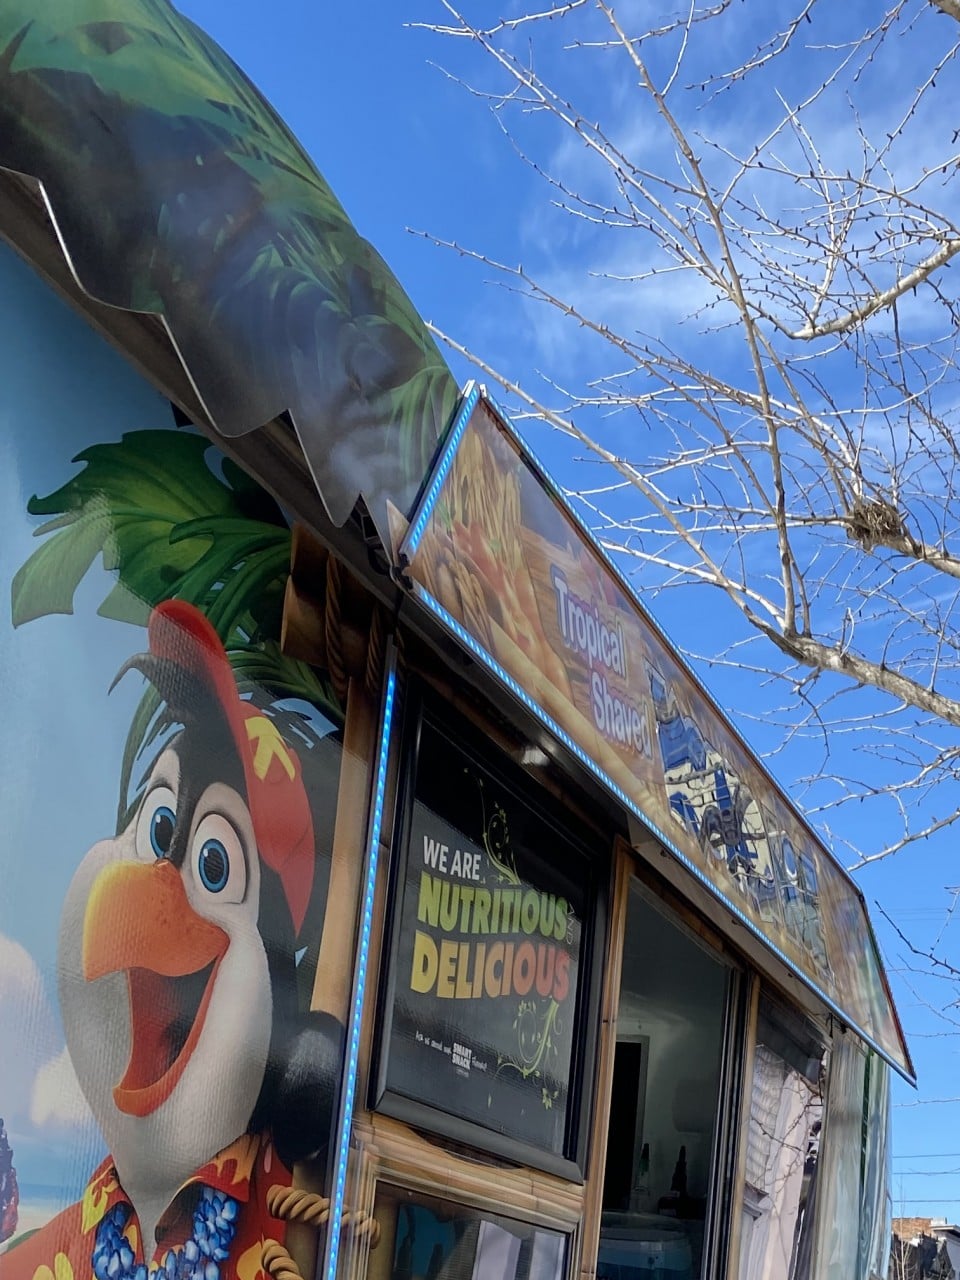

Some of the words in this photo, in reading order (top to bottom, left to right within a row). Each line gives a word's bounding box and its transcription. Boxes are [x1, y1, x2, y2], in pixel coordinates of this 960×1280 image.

[554, 575, 626, 680] Tropical
[590, 670, 653, 760] Shaved
[423, 835, 449, 874] WE
[450, 850, 482, 881] ARE
[417, 870, 569, 941] NUTRITIOUS
[410, 929, 571, 1000] DELICIOUS
